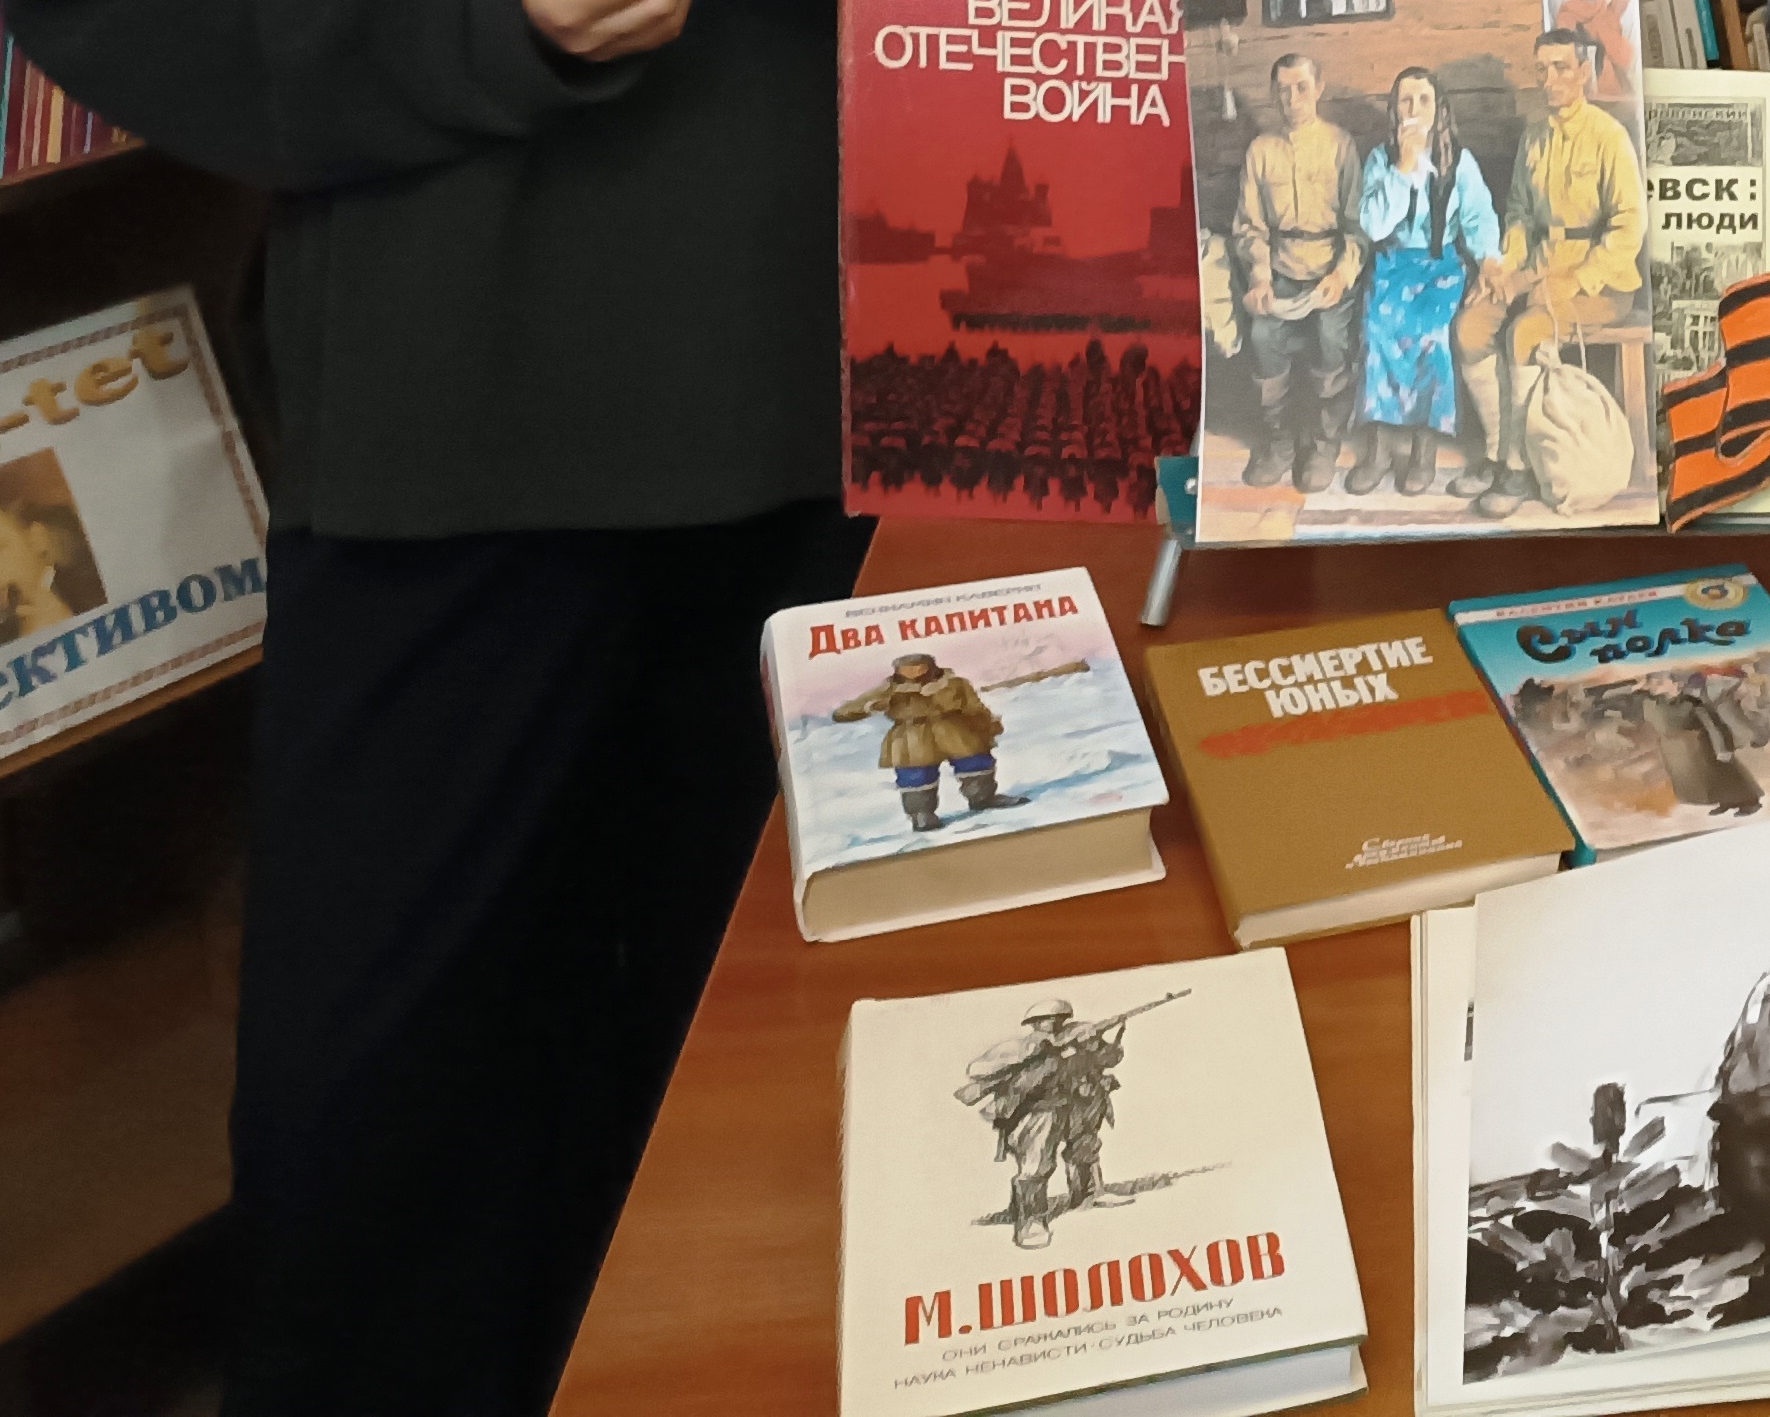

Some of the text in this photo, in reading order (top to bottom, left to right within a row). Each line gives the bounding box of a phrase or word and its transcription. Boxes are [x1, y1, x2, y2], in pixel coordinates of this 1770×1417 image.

[1003, 77, 1171, 128] ВОЙНА
[1197, 635, 1434, 698] БЕССМЕРТИЕ
[1264, 672, 1400, 720] ЮНЫХ
[893, 1366, 957, 1391] НАУКА
[1183, 1306, 1284, 1334] ЧЕЛОВЕКА
[942, 1296, 1235, 1363] ОНИ СРАЖАЛИСЬ ЗА РОДИНУ
